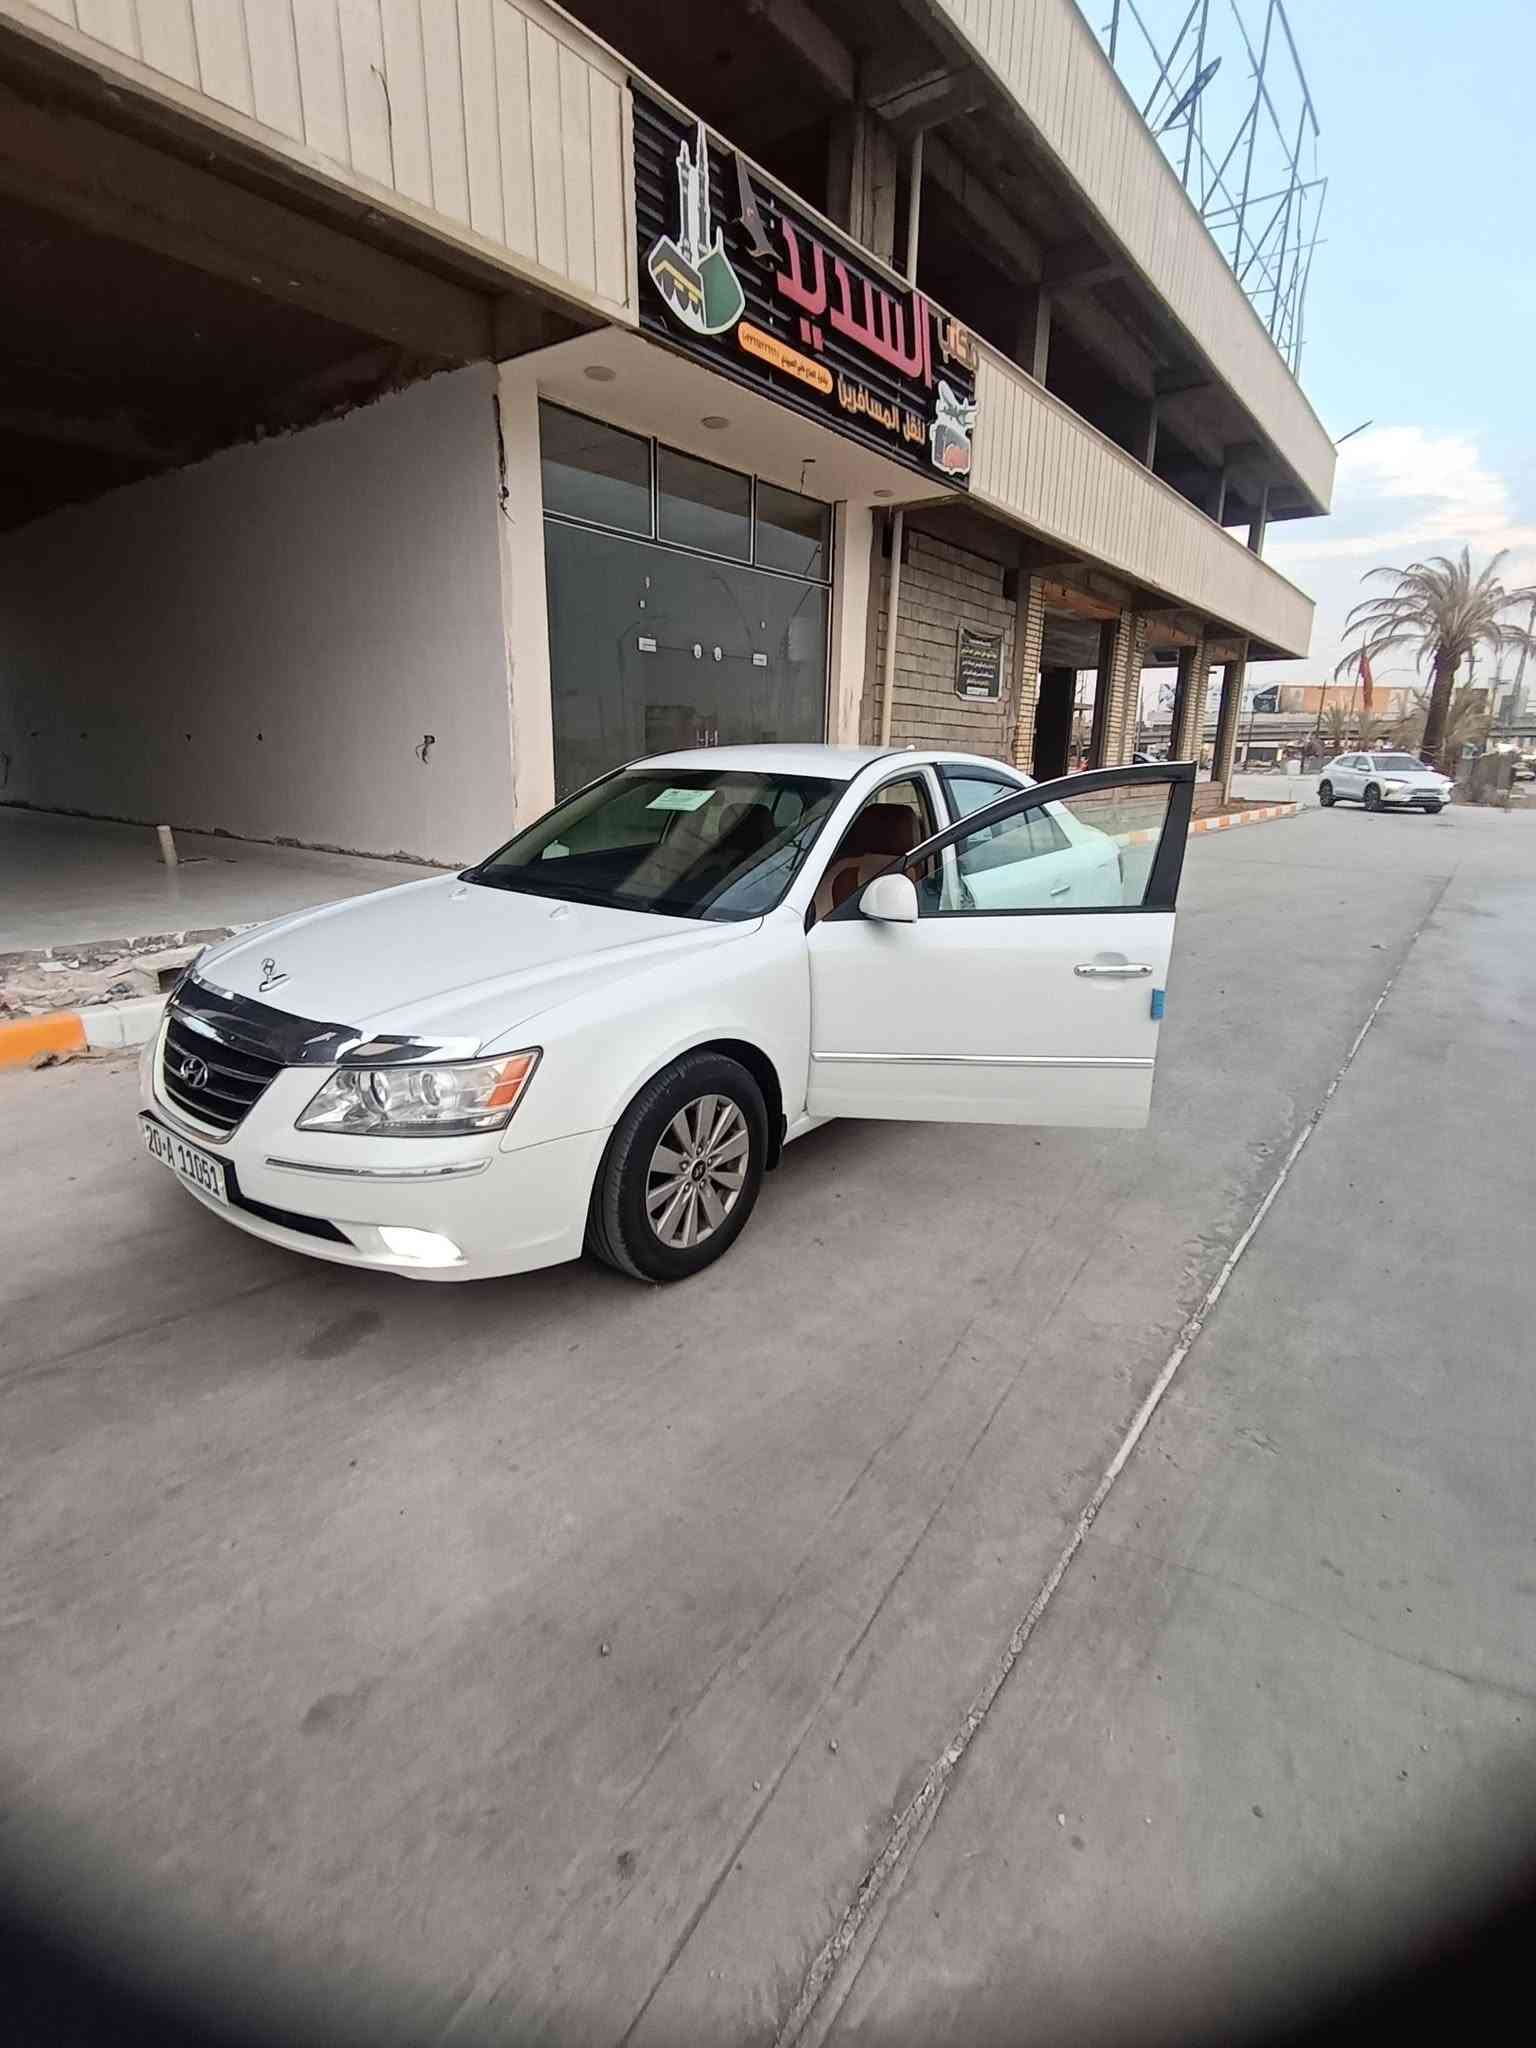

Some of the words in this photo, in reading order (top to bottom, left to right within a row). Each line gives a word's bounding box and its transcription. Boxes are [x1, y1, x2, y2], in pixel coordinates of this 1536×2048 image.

[776, 216, 932, 390] السديد
[837, 373, 901, 433] المسافرين
[177, 1144, 221, 1197] 11051
